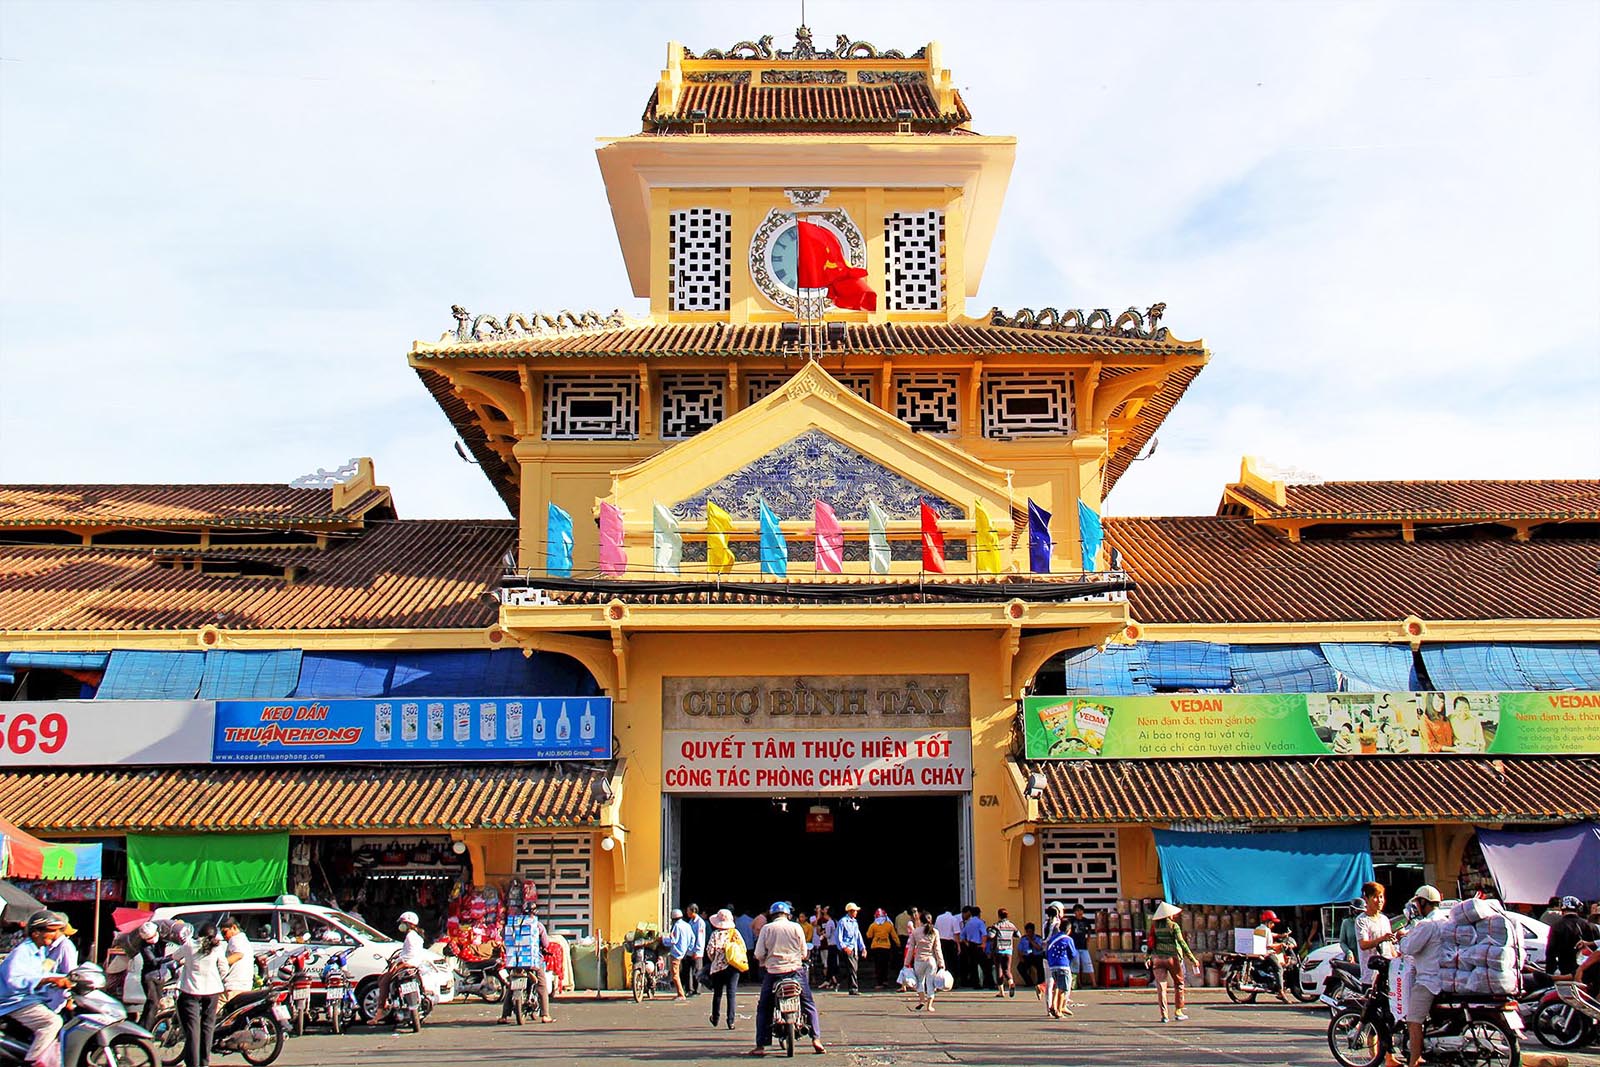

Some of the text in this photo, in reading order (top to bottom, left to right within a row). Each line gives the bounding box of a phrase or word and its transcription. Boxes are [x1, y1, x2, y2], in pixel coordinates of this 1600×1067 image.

[682, 679, 949, 723] CHỢ BÌNH TÂY
[1170, 699, 1223, 712] VEDAN
[1548, 695, 1600, 708] VEDAN
[260, 702, 330, 721] KEO DÁN
[1079, 711, 1107, 724] VEDAN
[0, 713, 68, 754] 69
[215, 753, 325, 761] www.keodanthuanphong.com
[681, 733, 952, 762] QUYẾT TÂM THỰC HIỆN TỐT
[665, 763, 965, 786] CÔNG TÁC PHÒNG CHÁY CHỮA CHÁY
